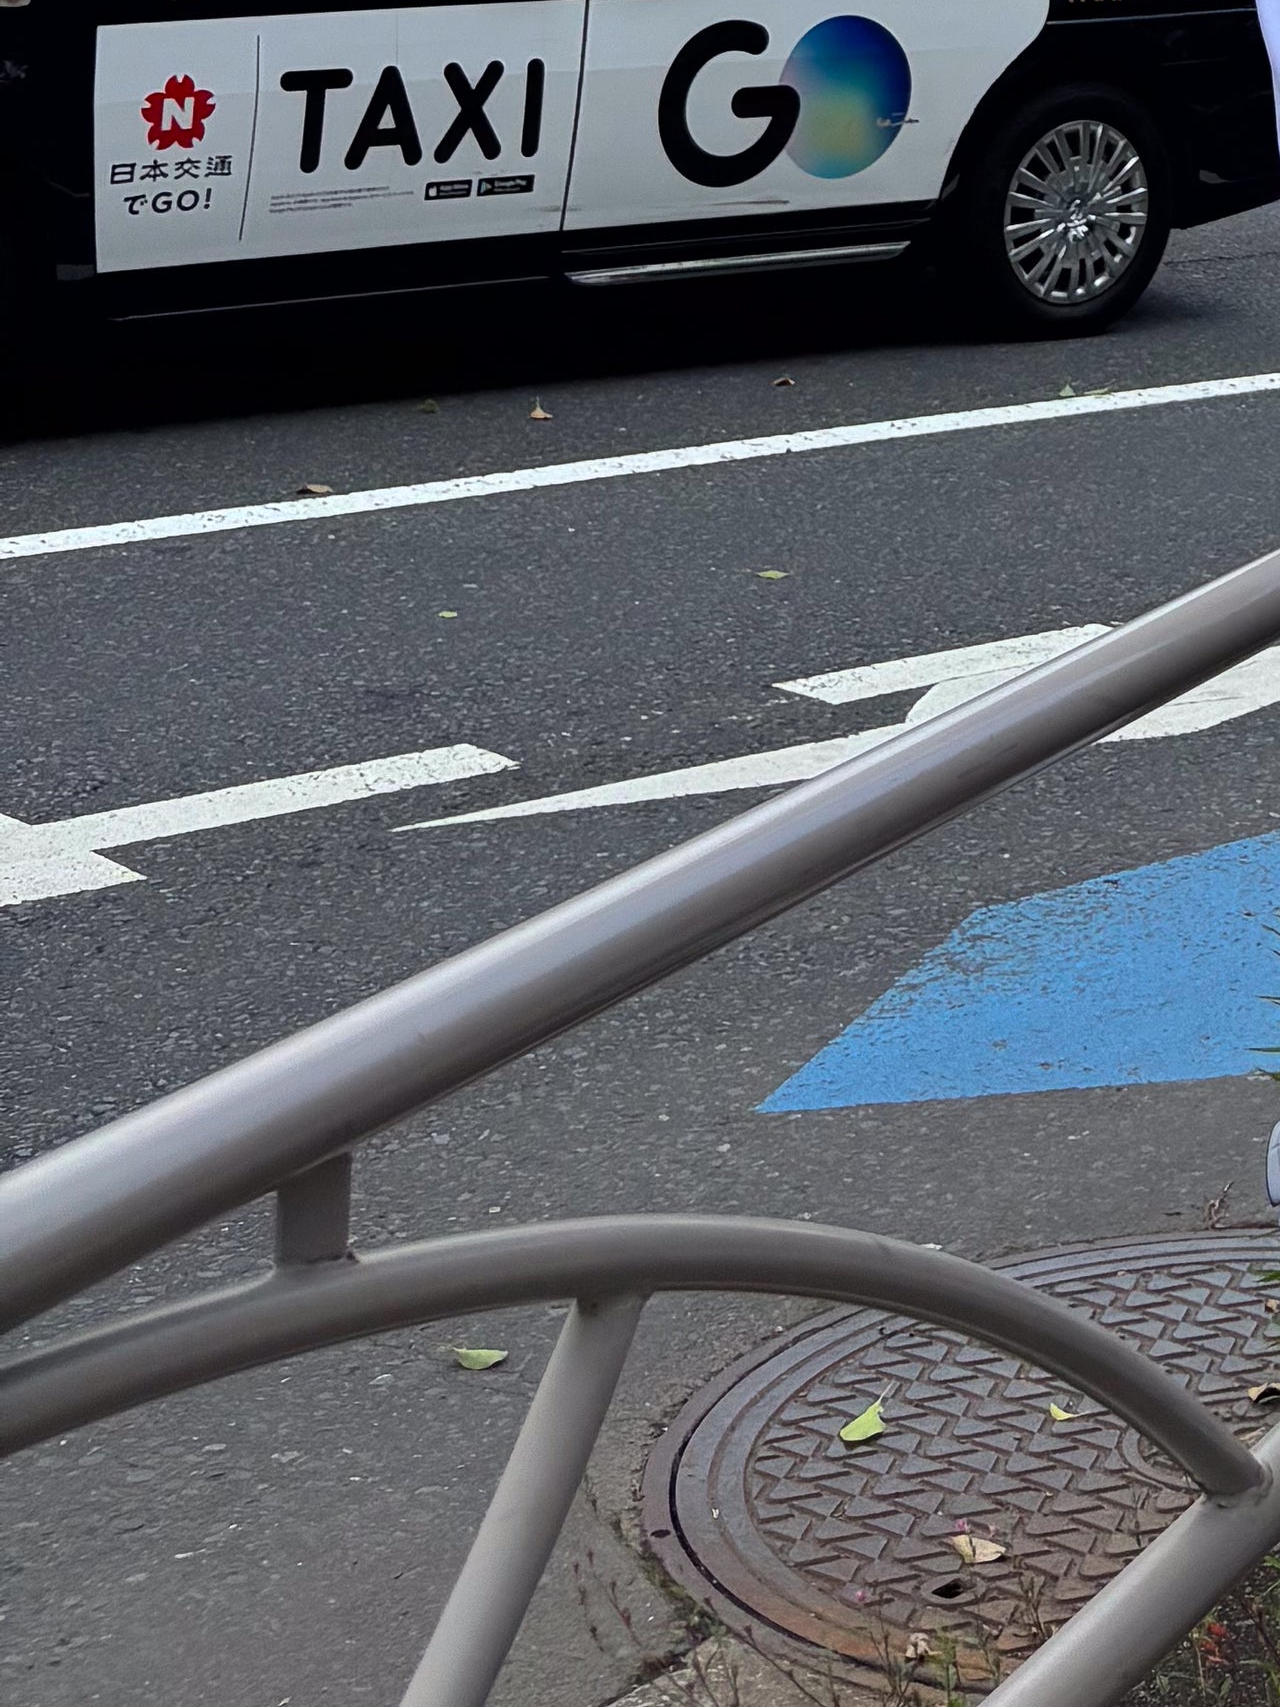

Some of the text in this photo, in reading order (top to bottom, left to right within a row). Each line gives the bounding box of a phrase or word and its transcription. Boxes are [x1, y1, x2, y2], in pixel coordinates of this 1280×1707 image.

[279, 57, 546, 175] TAXI
[109, 154, 233, 186] 日本交通
[123, 187, 213, 216] でGO!
